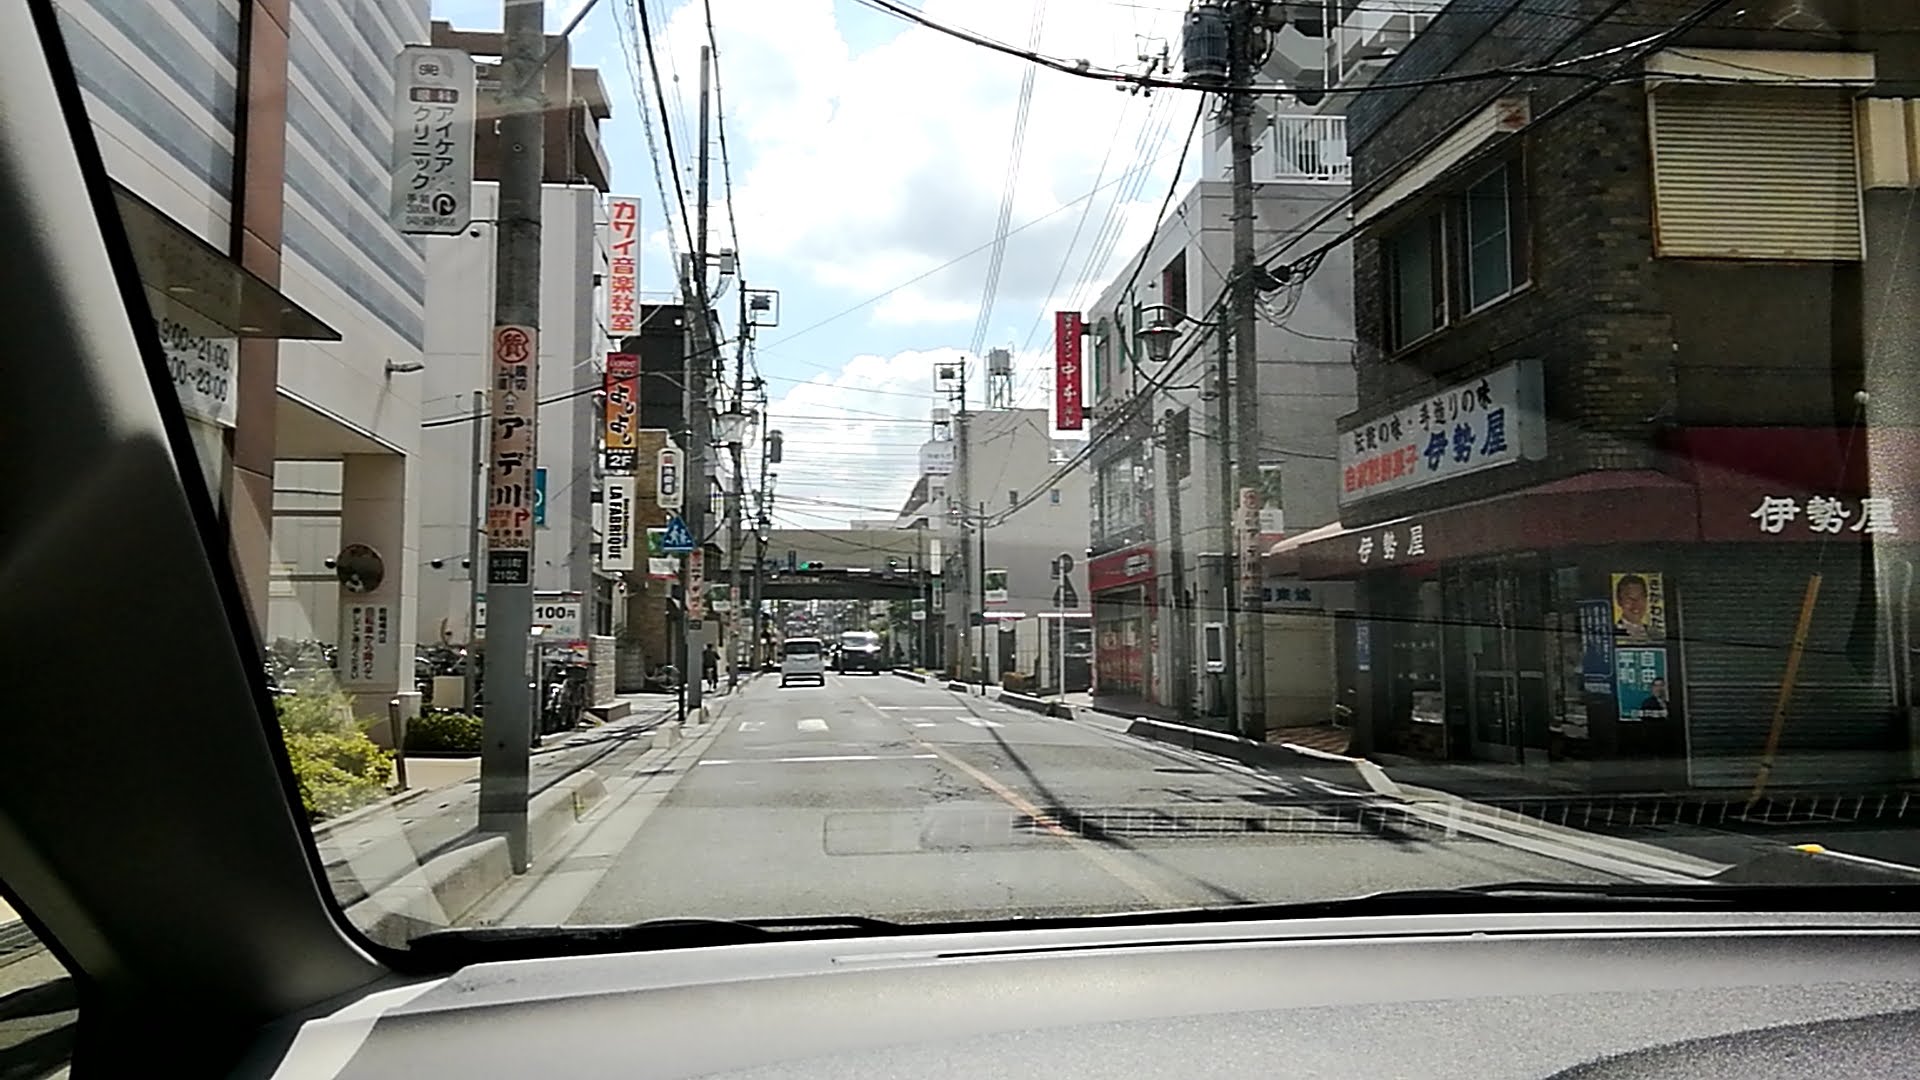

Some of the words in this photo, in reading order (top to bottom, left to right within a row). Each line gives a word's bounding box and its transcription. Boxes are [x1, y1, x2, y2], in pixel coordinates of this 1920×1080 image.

[411, 106, 431, 190] クリニック
[435, 106, 455, 173] アイケア
[611, 201, 636, 332] カワイ音楽教室
[609, 455, 632, 467] 2F
[1424, 408, 1507, 471] 伊勢屋
[609, 486, 623, 500] LA
[1750, 495, 1898, 534] 伊勢屋
[607, 502, 622, 560] FABRIQUE
[1358, 524, 1425, 564] 伊勢屋
[535, 606, 576, 619] 100円
